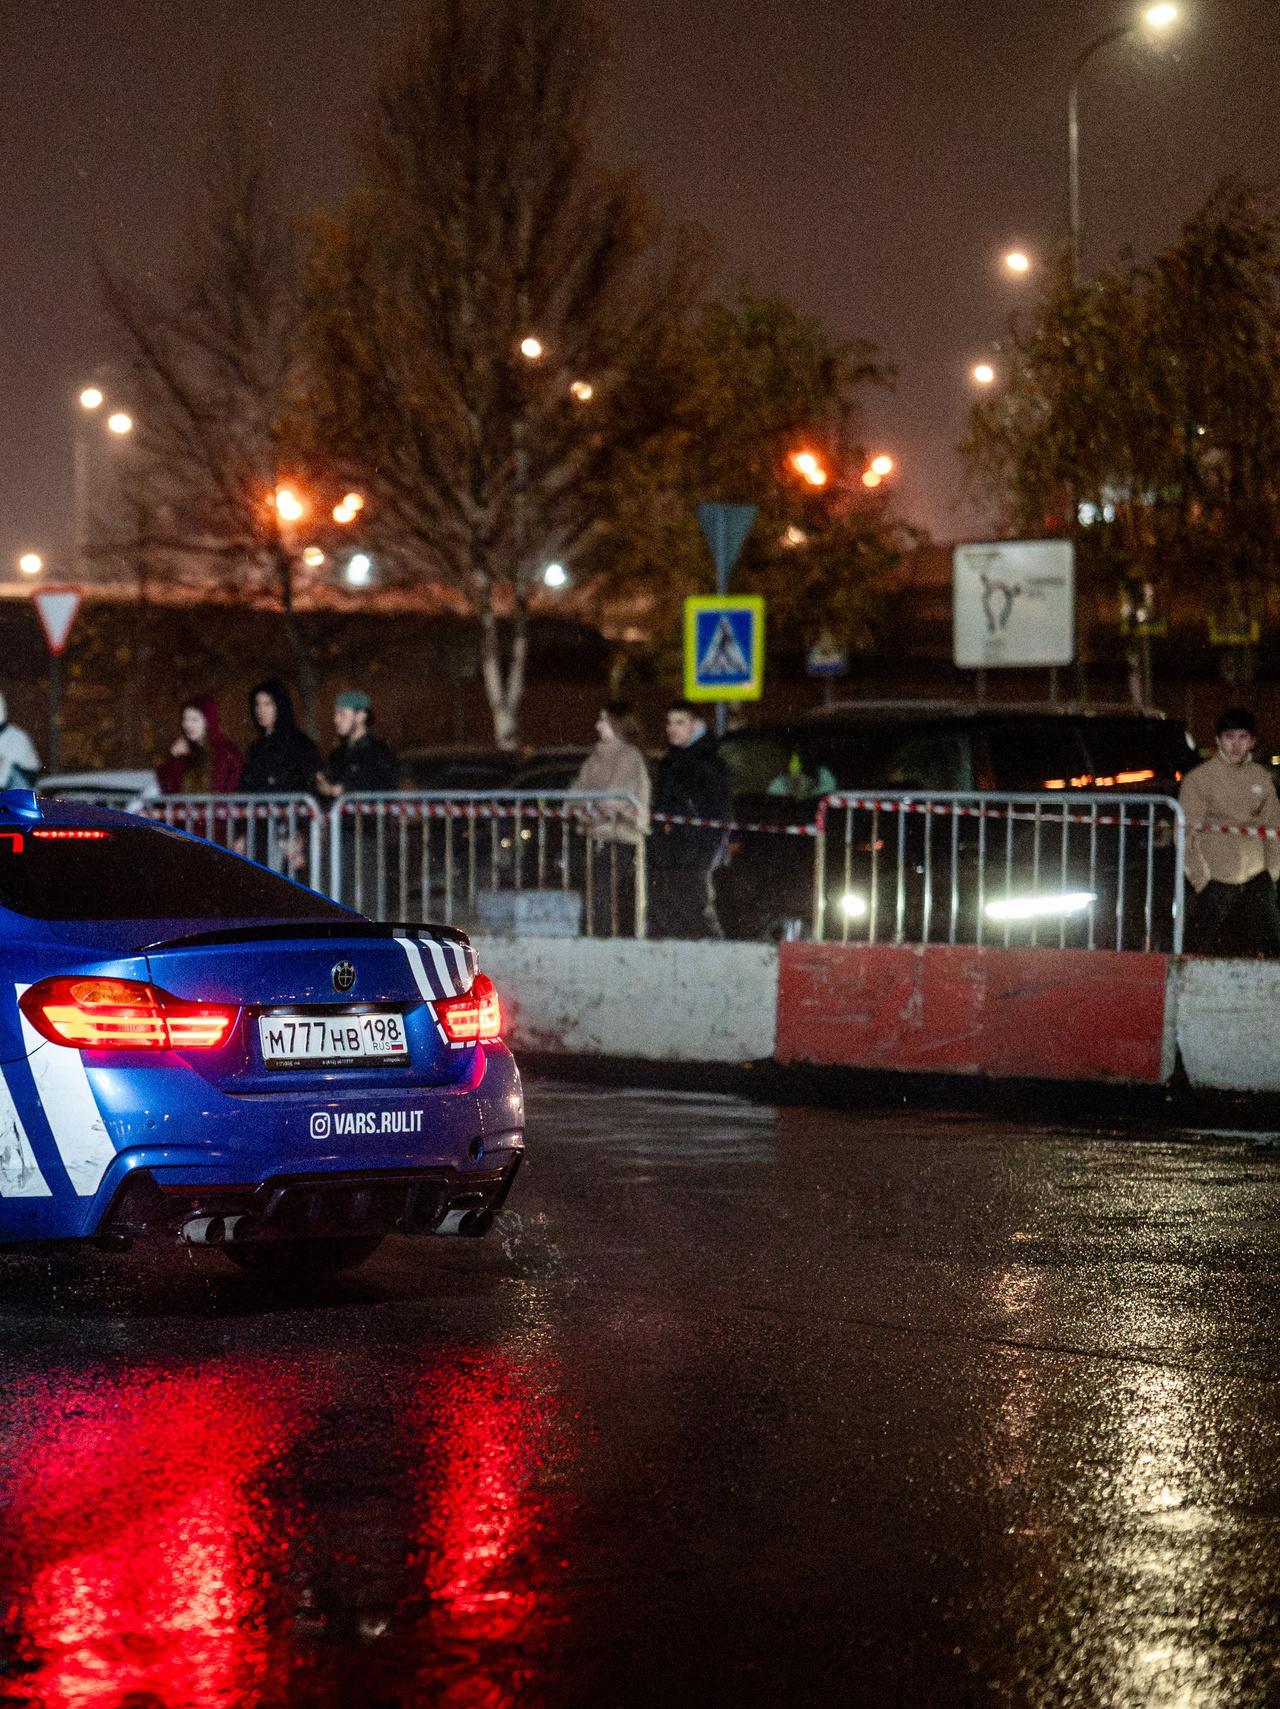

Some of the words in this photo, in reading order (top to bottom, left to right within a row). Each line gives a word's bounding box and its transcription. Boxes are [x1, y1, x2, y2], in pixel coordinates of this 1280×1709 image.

[364, 1018, 399, 1041] 198
[373, 1041, 391, 1051] RUS
[334, 1110, 424, 1135] VARS.RULIT
